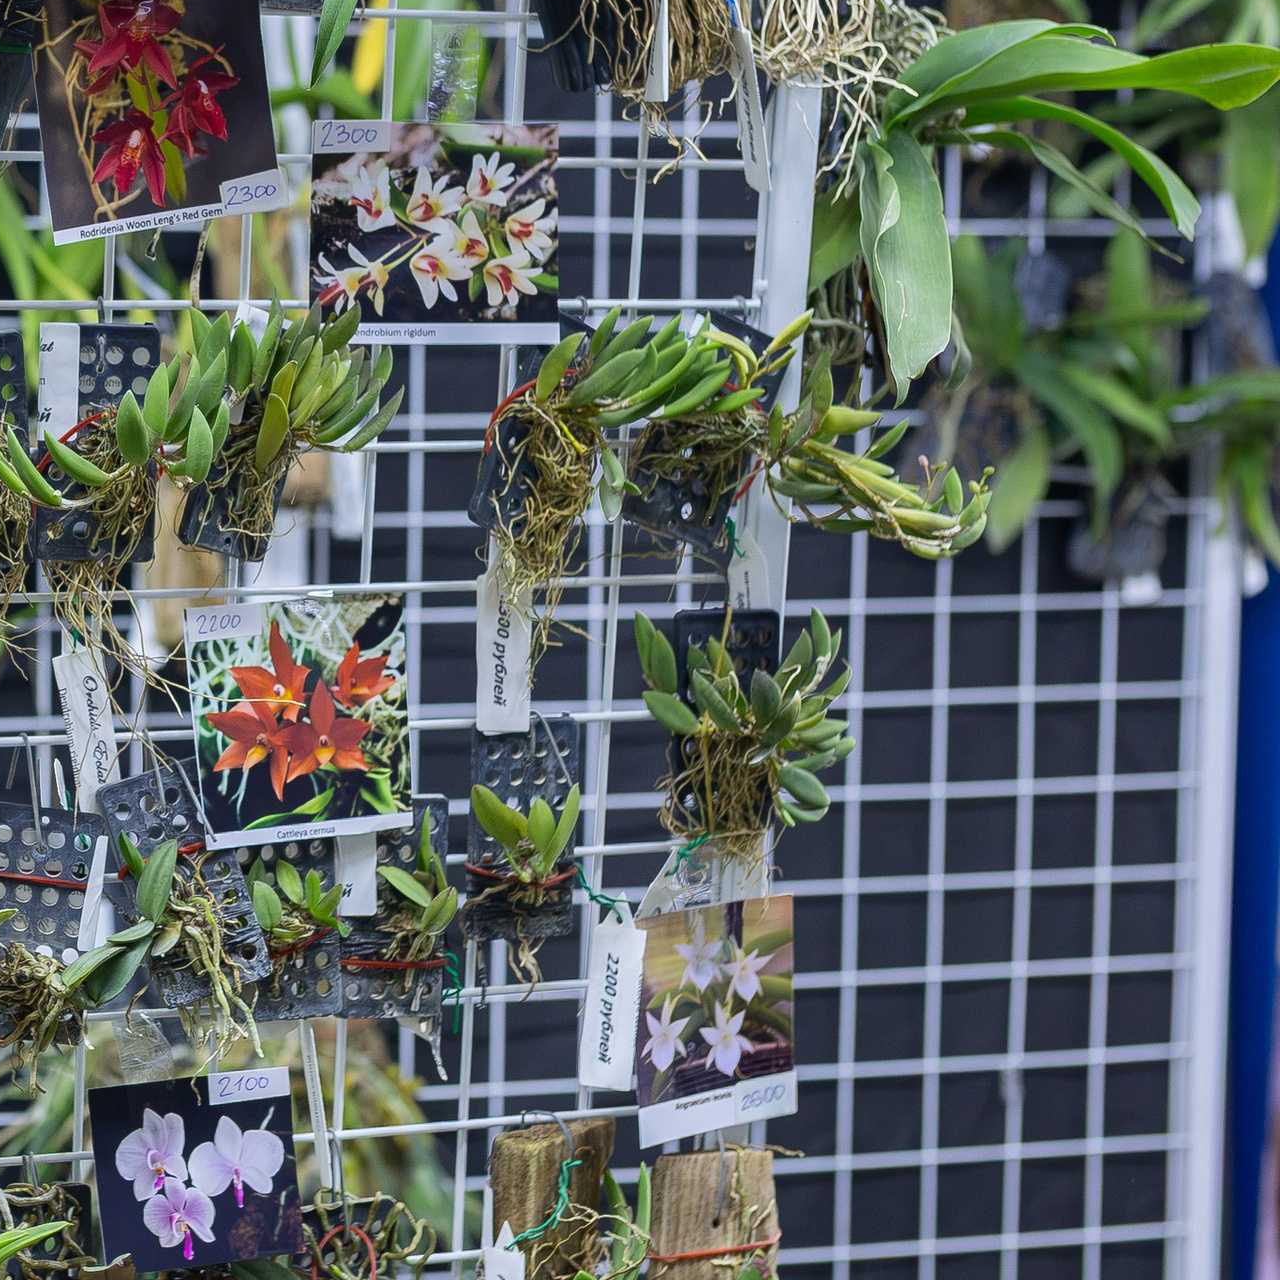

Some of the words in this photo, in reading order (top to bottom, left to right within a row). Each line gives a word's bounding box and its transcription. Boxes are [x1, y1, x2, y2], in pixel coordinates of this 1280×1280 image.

[321, 121, 377, 147] 2300
[225, 184, 277, 206] 2300
[80, 223, 125, 239] Rodridenia
[125, 218, 152, 230] Woon
[153, 213, 180, 226] Leng's
[182, 210, 199, 221] Red
[201, 207, 223, 218] Gem
[355, 328, 401, 337] endrobium
[404, 328, 436, 339] rigidum
[196, 614, 241, 635] 2200
[492, 641, 507, 707] рублей
[277, 829, 308, 839] Cattleya
[309, 827, 336, 836] cernua
[603, 952, 620, 997] 2200
[597, 1002, 615, 1065] рублей
[218, 1076, 269, 1097] 2100
